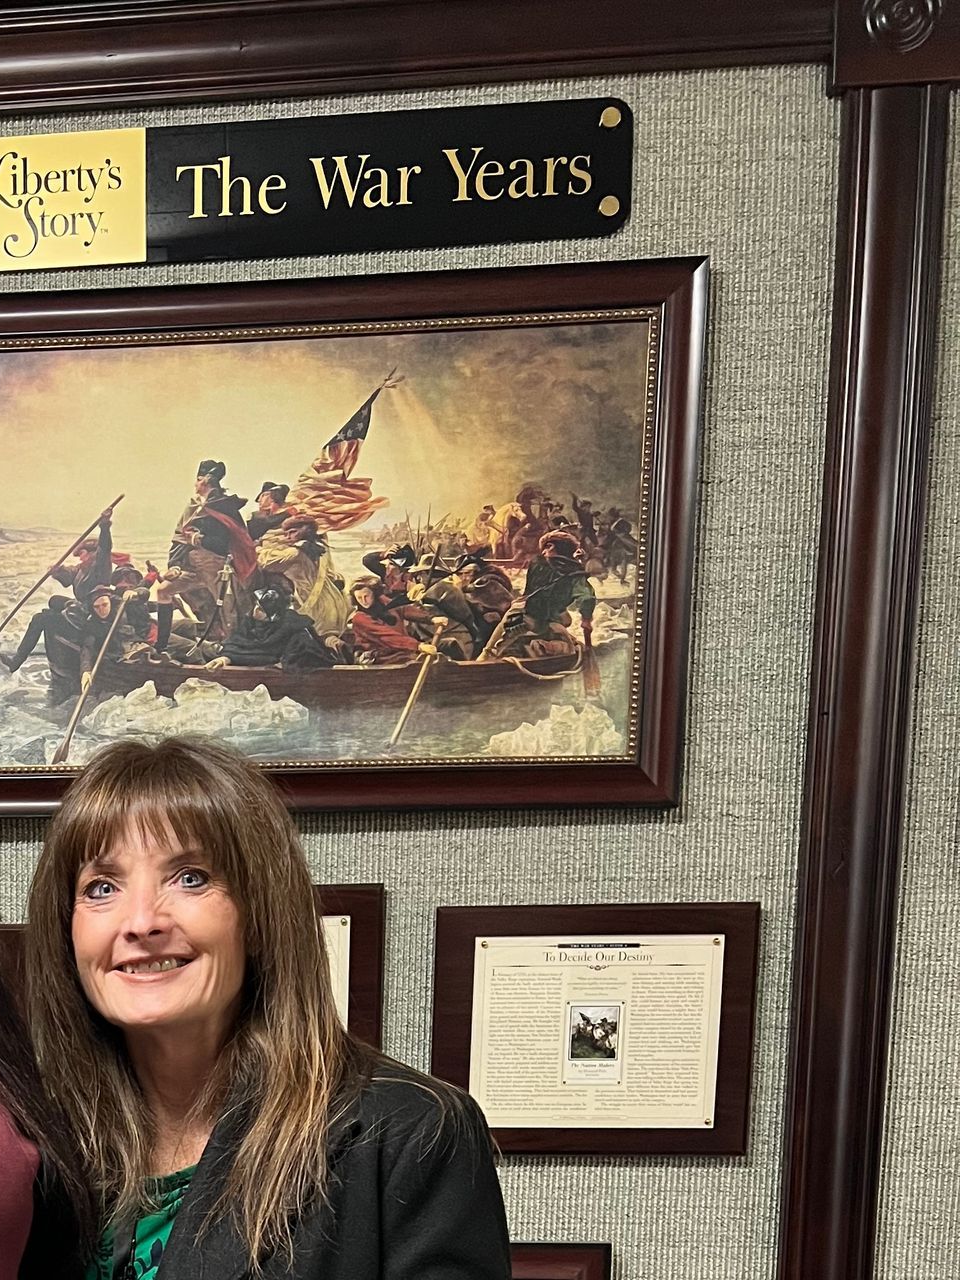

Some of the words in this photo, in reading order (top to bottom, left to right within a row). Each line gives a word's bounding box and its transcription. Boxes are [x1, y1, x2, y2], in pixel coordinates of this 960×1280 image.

[175, 156, 288, 219] The
[309, 154, 422, 210] War
[442, 147, 593, 202] Years
[543, 951, 556, 962] To
[559, 951, 592, 962] Decide
[595, 951, 615, 961] Our
[619, 951, 655, 966] Destiny
